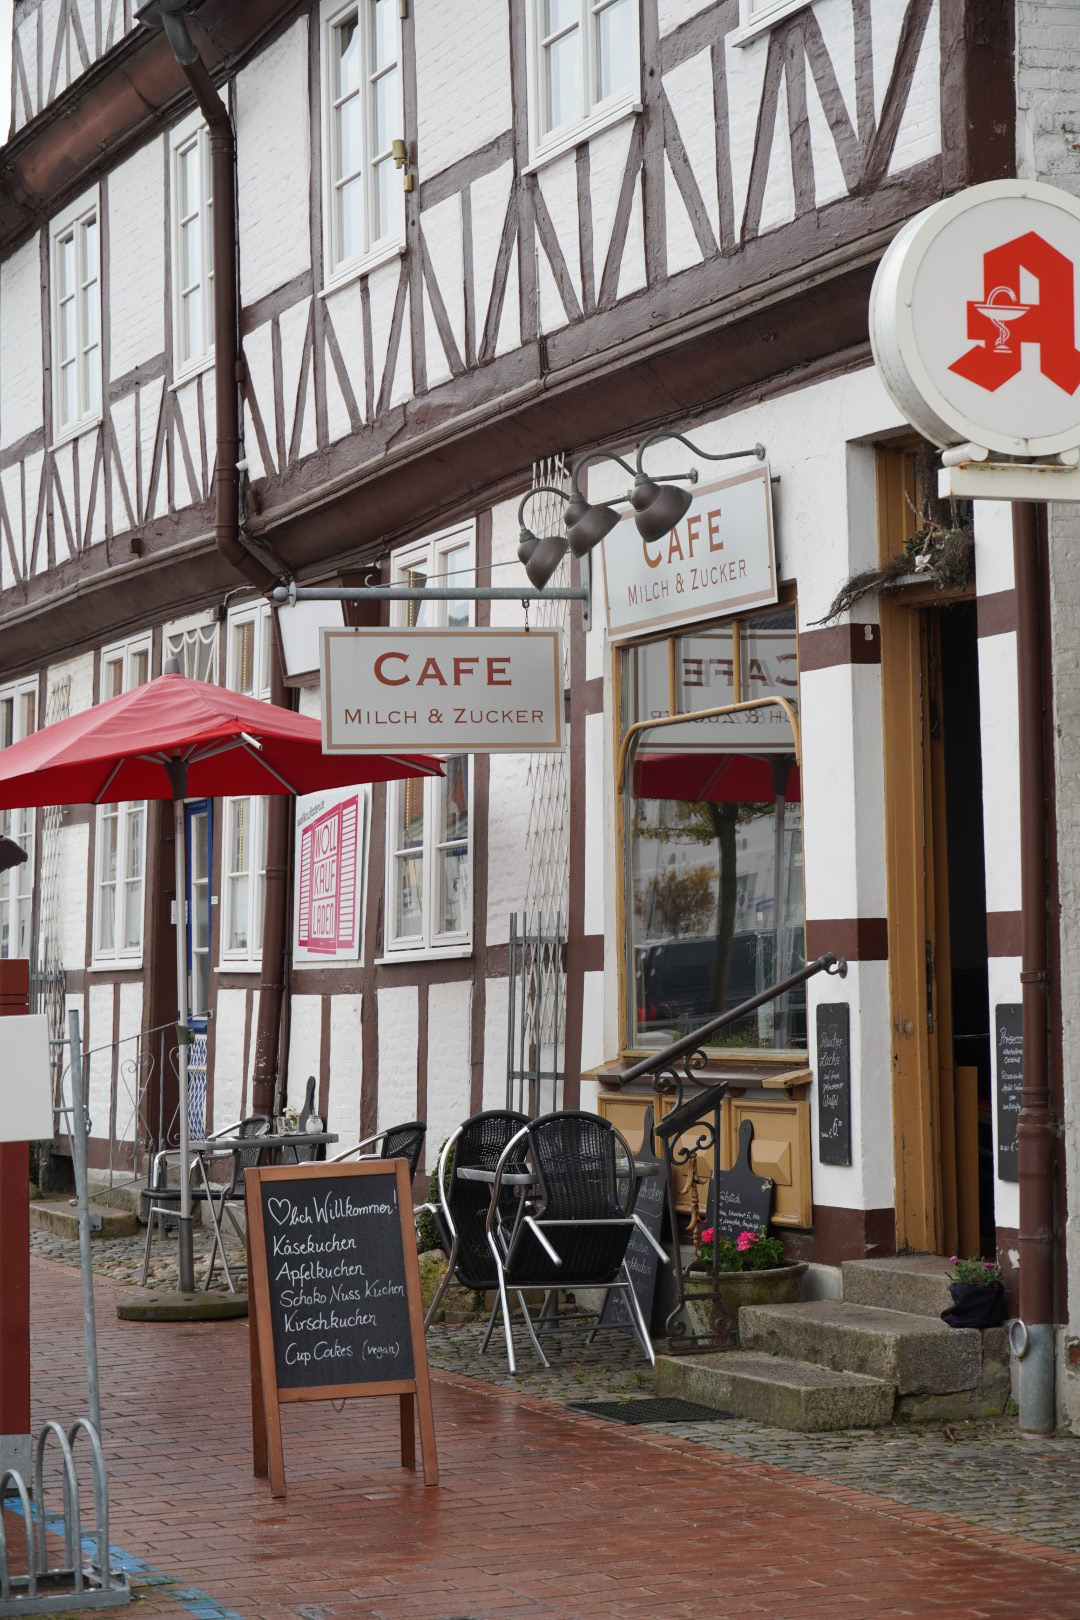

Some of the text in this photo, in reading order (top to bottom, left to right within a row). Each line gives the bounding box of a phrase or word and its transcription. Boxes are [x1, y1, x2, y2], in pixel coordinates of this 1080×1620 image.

[627, 559, 747, 607] MILCH & ZUCKER
[374, 651, 512, 687] CAFE
[344, 708, 544, 725] MILCH & ZUCKER
[313, 818, 337, 859] WOLL
[313, 859, 336, 896] KAUF
[312, 902, 335, 935] LADEN
[313, 1189, 397, 1224] Willkommen!
[273, 1233, 357, 1257] Käsekuchen
[275, 1259, 366, 1288] Apfelkuchen
[280, 1279, 405, 1308] Schoko Nuss Kuchen
[284, 1308, 378, 1333] Kirschkuchen
[285, 1338, 400, 1366] Cup Cakes (vegan)
